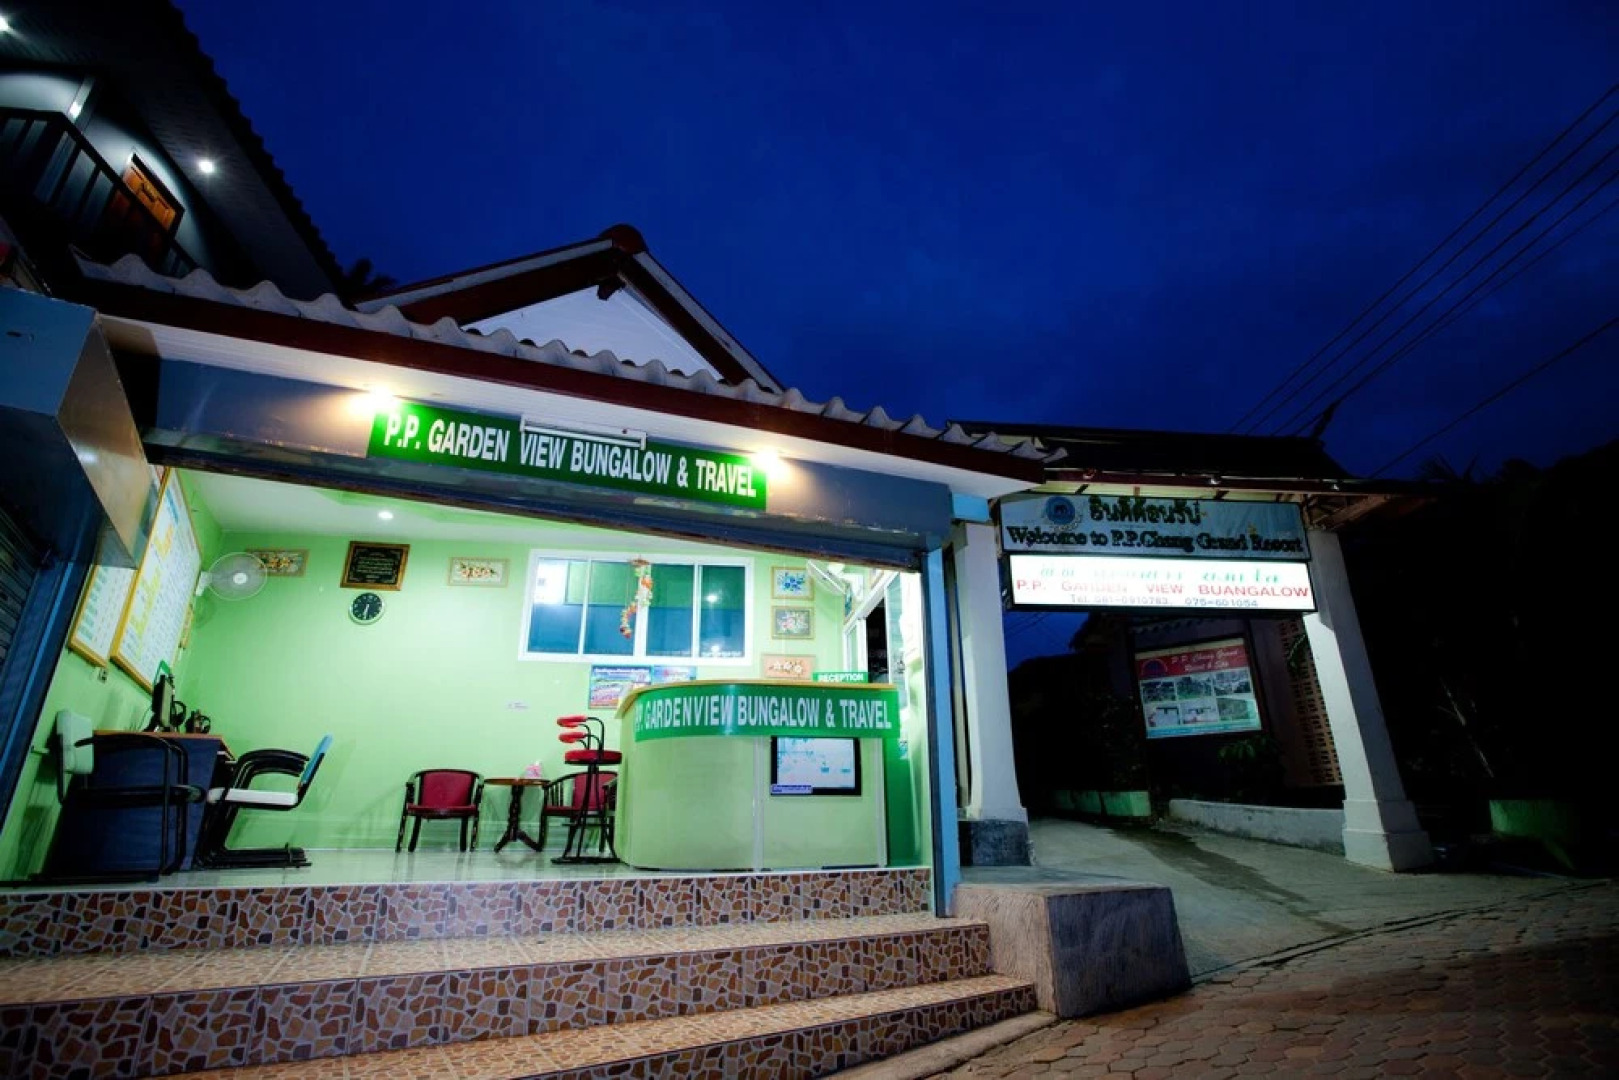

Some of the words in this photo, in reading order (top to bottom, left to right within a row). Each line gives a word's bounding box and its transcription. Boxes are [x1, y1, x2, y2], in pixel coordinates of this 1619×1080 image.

[384, 413, 422, 450] P.P.
[428, 419, 511, 463] GARDEN
[519, 432, 566, 470] VIEW
[570, 439, 673, 485] BUNGALOW
[676, 456, 689, 488] &
[695, 458, 758, 498] TRAVEL
[1006, 526, 1087, 546] Welcome
[1090, 530, 1108, 546] to
[1146, 583, 1183, 594] VIEW
[1198, 585, 1309, 597] BUANGALOW
[817, 673, 864, 683] RECEPTION
[738, 695, 820, 728] BUNGALOW
[826, 699, 836, 728] &
[839, 699, 892, 729] TRAVEL
